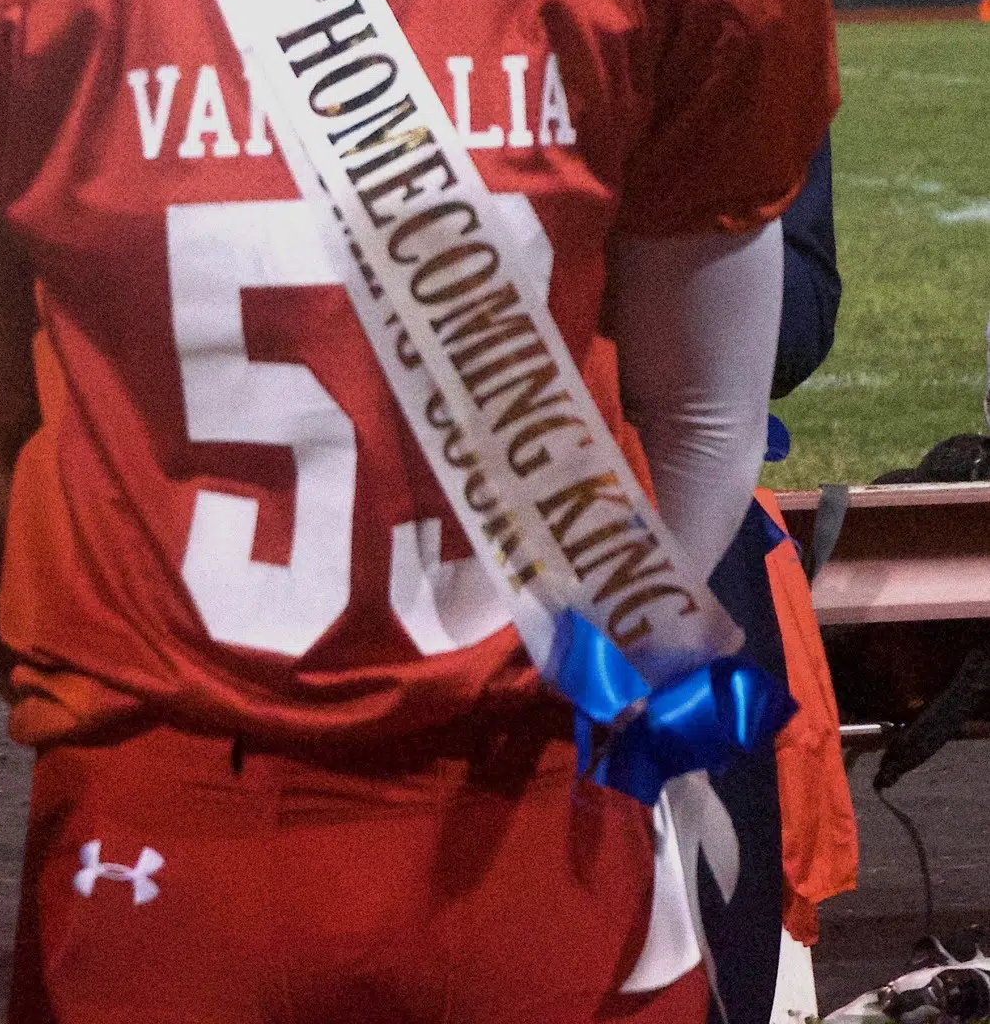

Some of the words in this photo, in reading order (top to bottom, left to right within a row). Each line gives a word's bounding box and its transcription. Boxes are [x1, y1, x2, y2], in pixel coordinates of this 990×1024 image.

[127, 54, 576, 160] VALIA
[276, 0, 593, 477] HOMECOMING
[536, 470, 697, 649] KING
